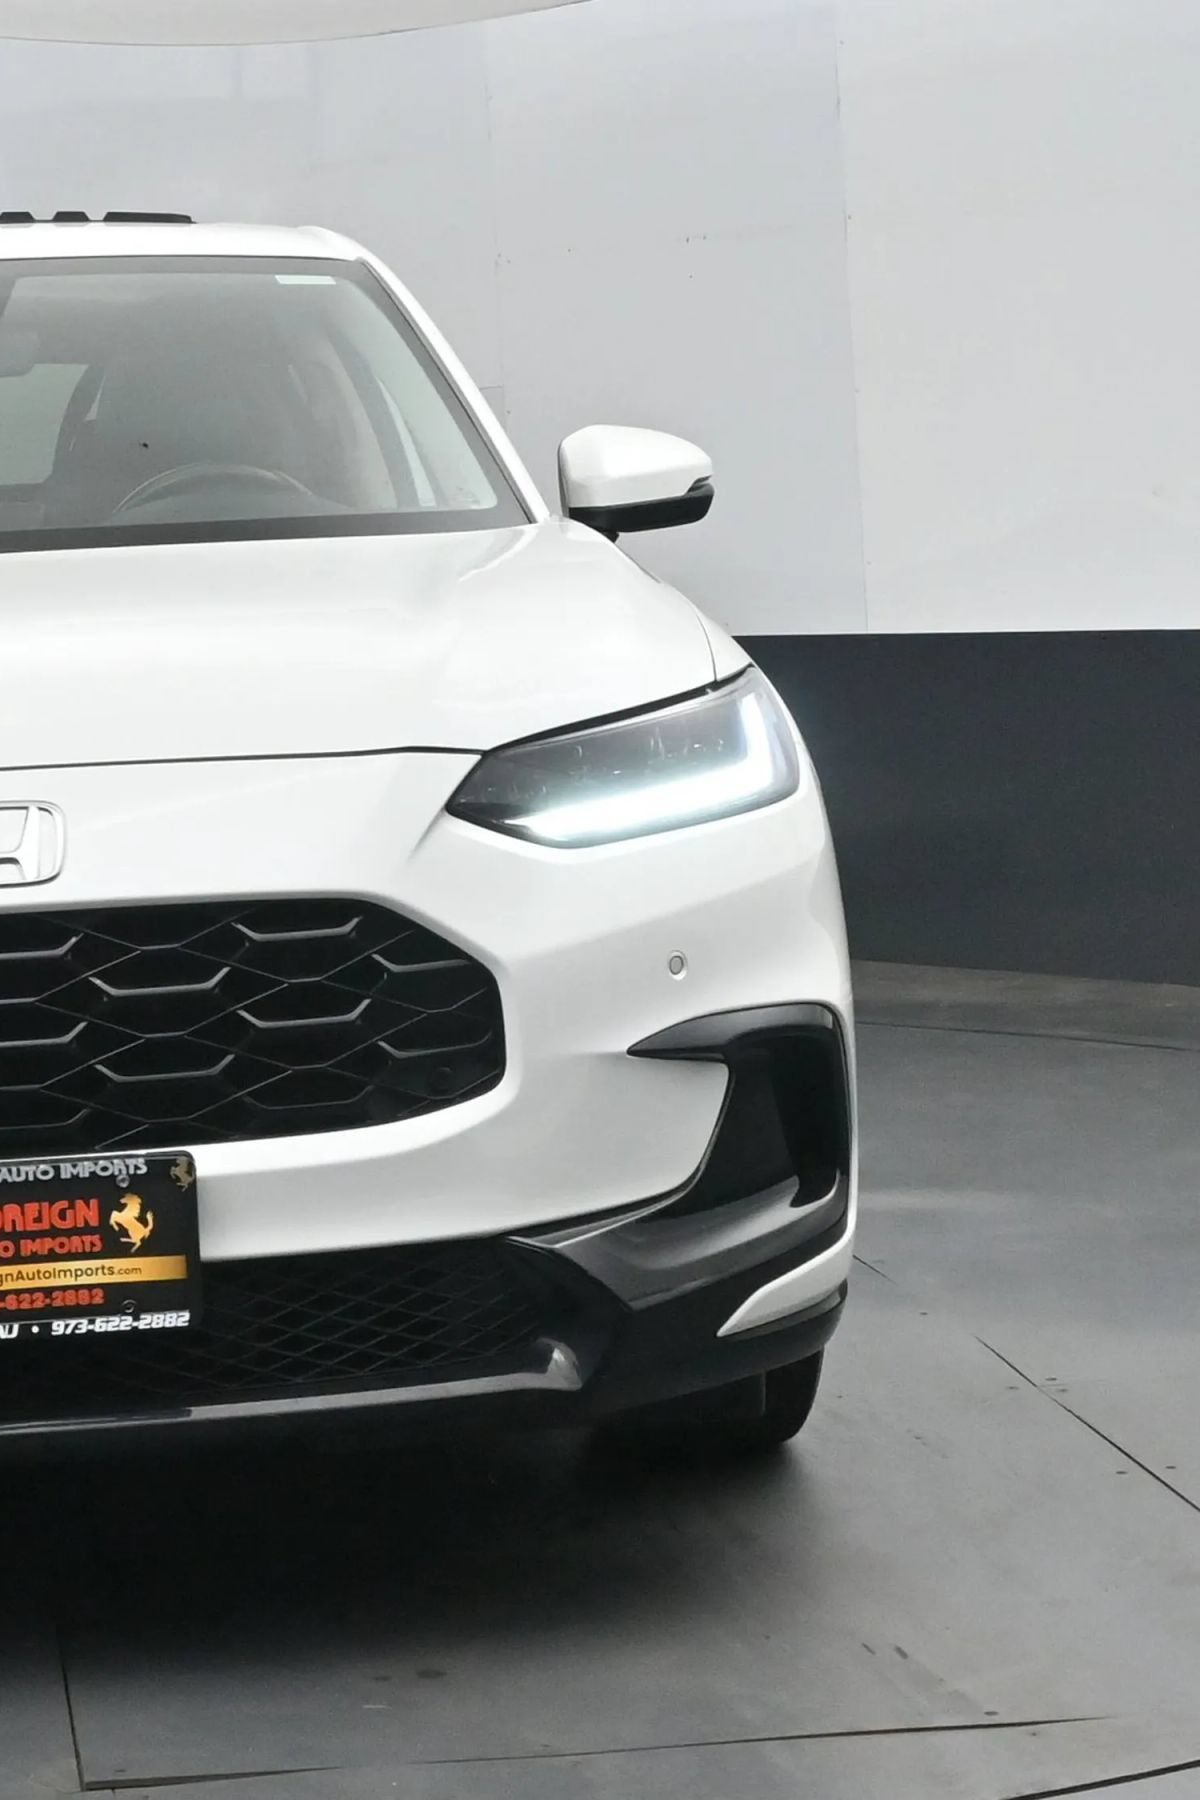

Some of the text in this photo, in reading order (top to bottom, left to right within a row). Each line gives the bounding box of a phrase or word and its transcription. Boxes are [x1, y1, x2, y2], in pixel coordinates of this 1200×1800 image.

[61, 1158, 147, 1178] IMPORTS
[21, 1235, 102, 1256] IMPORTS
[51, 1310, 190, 1335] 973-622-2882
